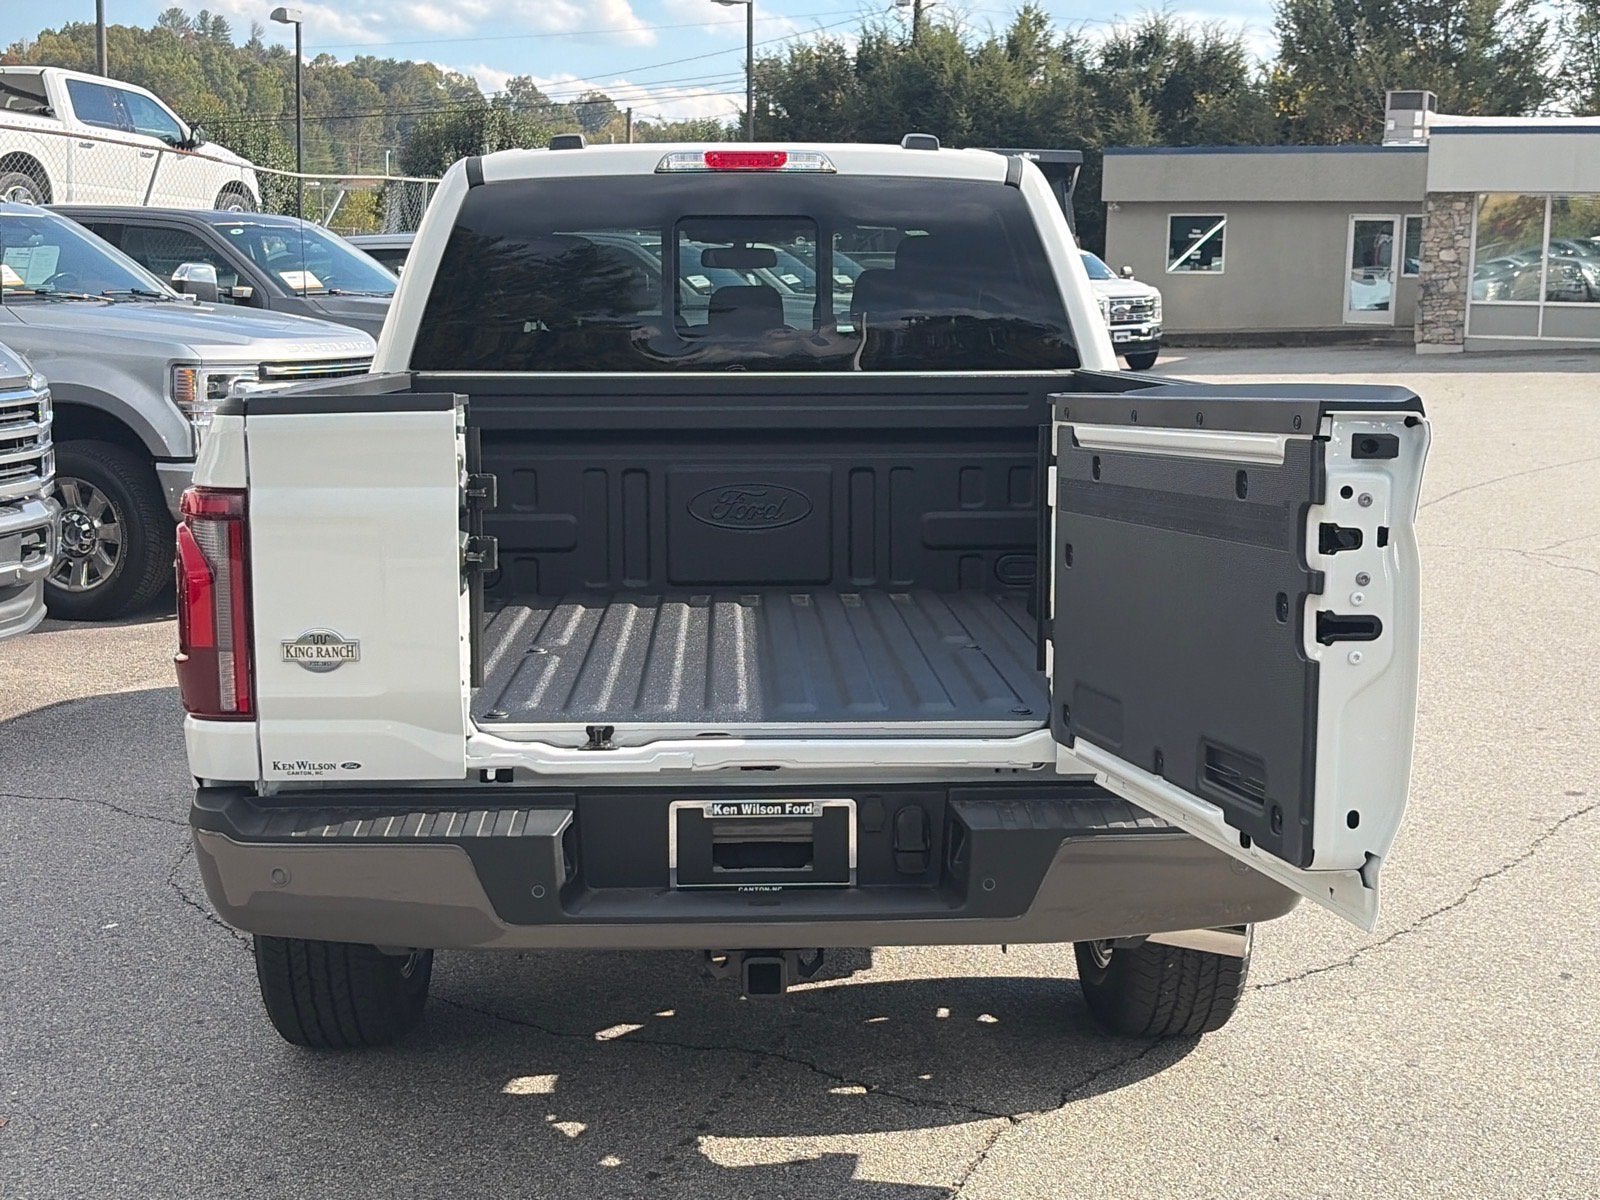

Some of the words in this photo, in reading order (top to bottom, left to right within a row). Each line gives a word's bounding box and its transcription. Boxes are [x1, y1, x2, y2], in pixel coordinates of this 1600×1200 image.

[710, 489, 788, 521] Ford
[285, 645, 313, 658] KING
[316, 645, 355, 658] RANCH
[272, 761, 295, 771] KEN
[296, 760, 337, 771] WILSON
[713, 804, 738, 815] Ken
[741, 803, 782, 815] Wilson
[785, 803, 813, 814] Ford
